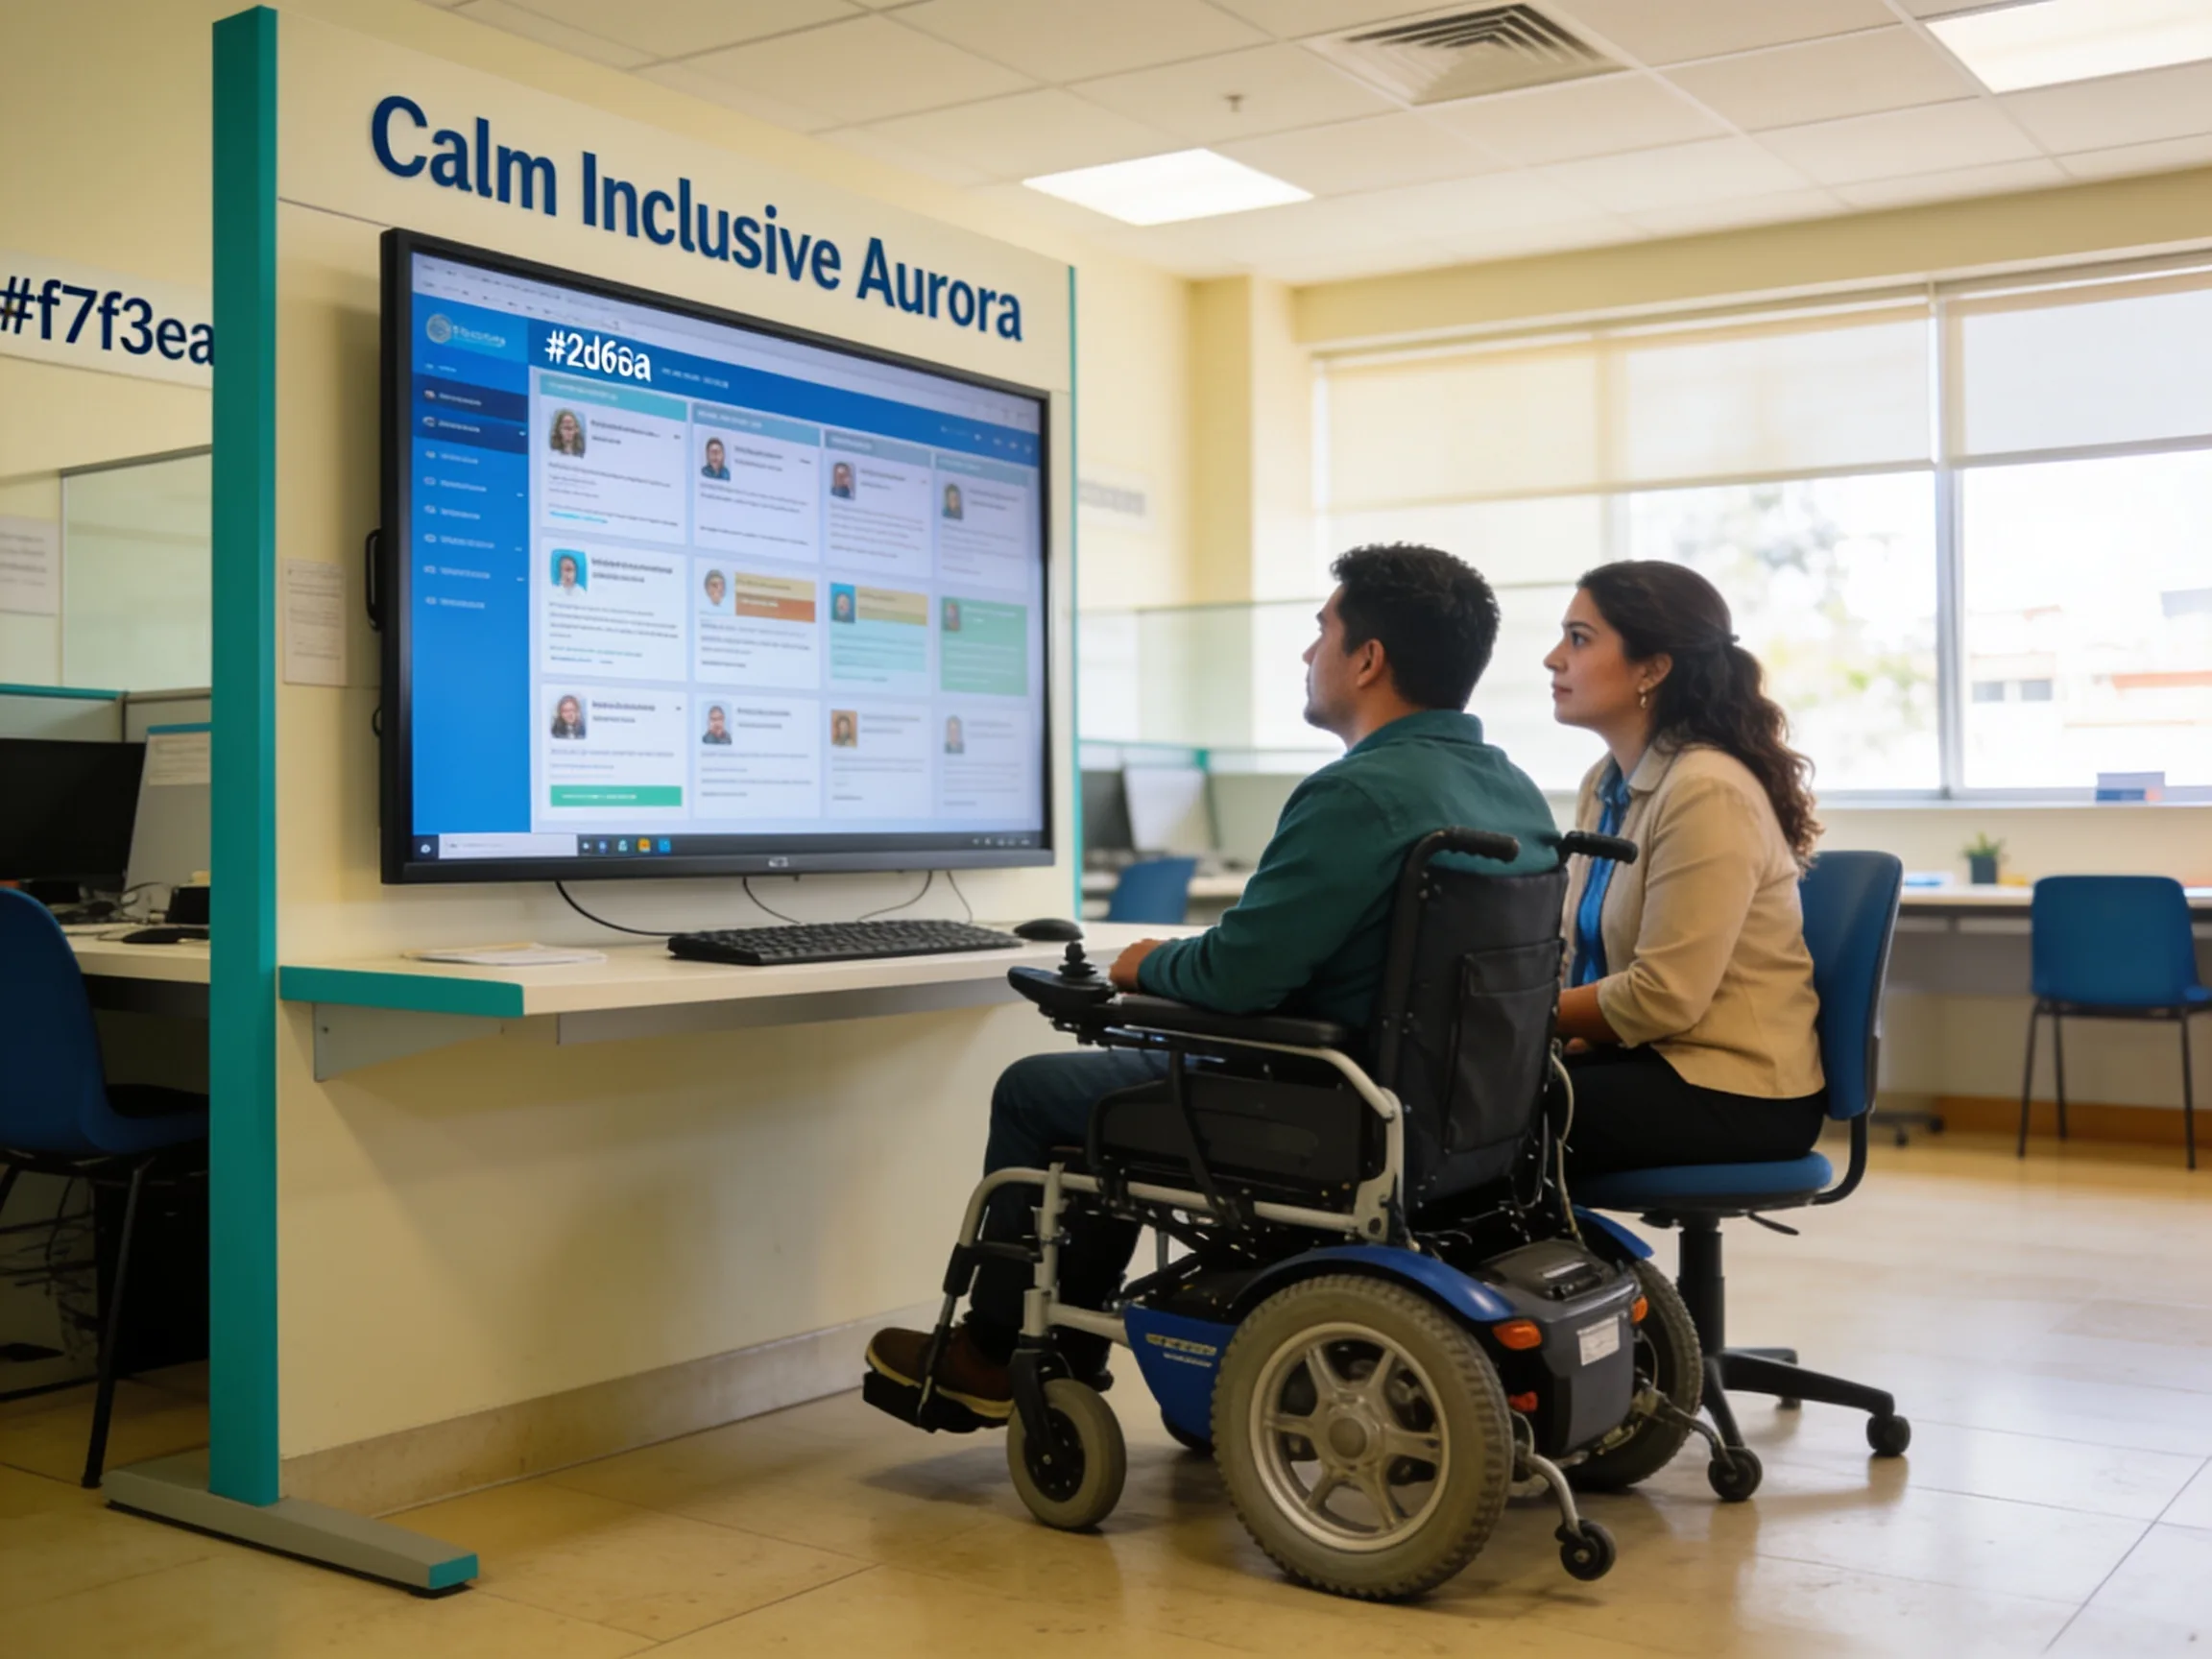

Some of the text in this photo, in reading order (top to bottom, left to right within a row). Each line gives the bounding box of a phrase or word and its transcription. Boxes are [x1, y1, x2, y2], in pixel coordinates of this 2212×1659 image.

[372, 96, 1022, 343] Calm Inclusive Aurora
[0, 276, 213, 367] #f7f3ea
